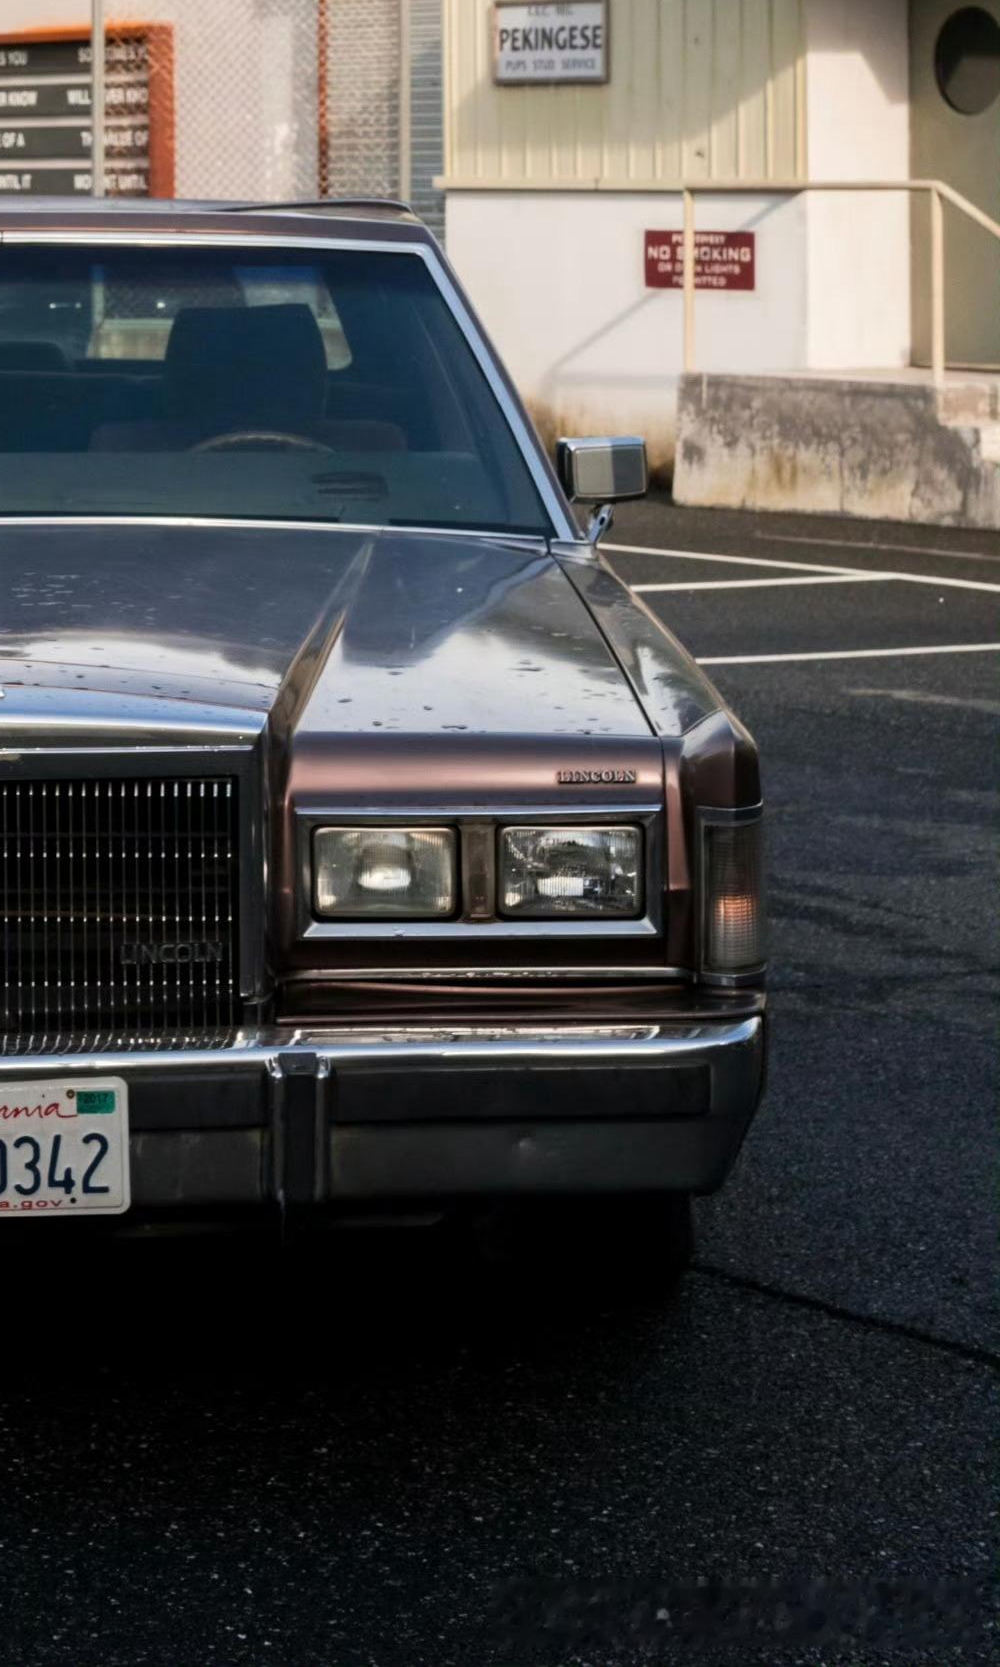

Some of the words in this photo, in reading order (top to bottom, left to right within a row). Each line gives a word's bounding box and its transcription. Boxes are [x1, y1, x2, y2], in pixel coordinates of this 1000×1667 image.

[499, 25, 603, 52] PEKINGESE
[8, 50, 28, 66] YOU
[9, 91, 38, 107] KNOW
[67, 89, 92, 105] WILL
[2, 132, 16, 148] OF
[16, 132, 26, 148] A
[22, 173, 32, 189] IT
[647, 245, 671, 261] NO
[704, 263, 741, 275] LIGHTS
[558, 770, 637, 784] LINCOLN
[120, 942, 222, 964] LINCOLN
[83, 1093, 108, 1104] 2017
